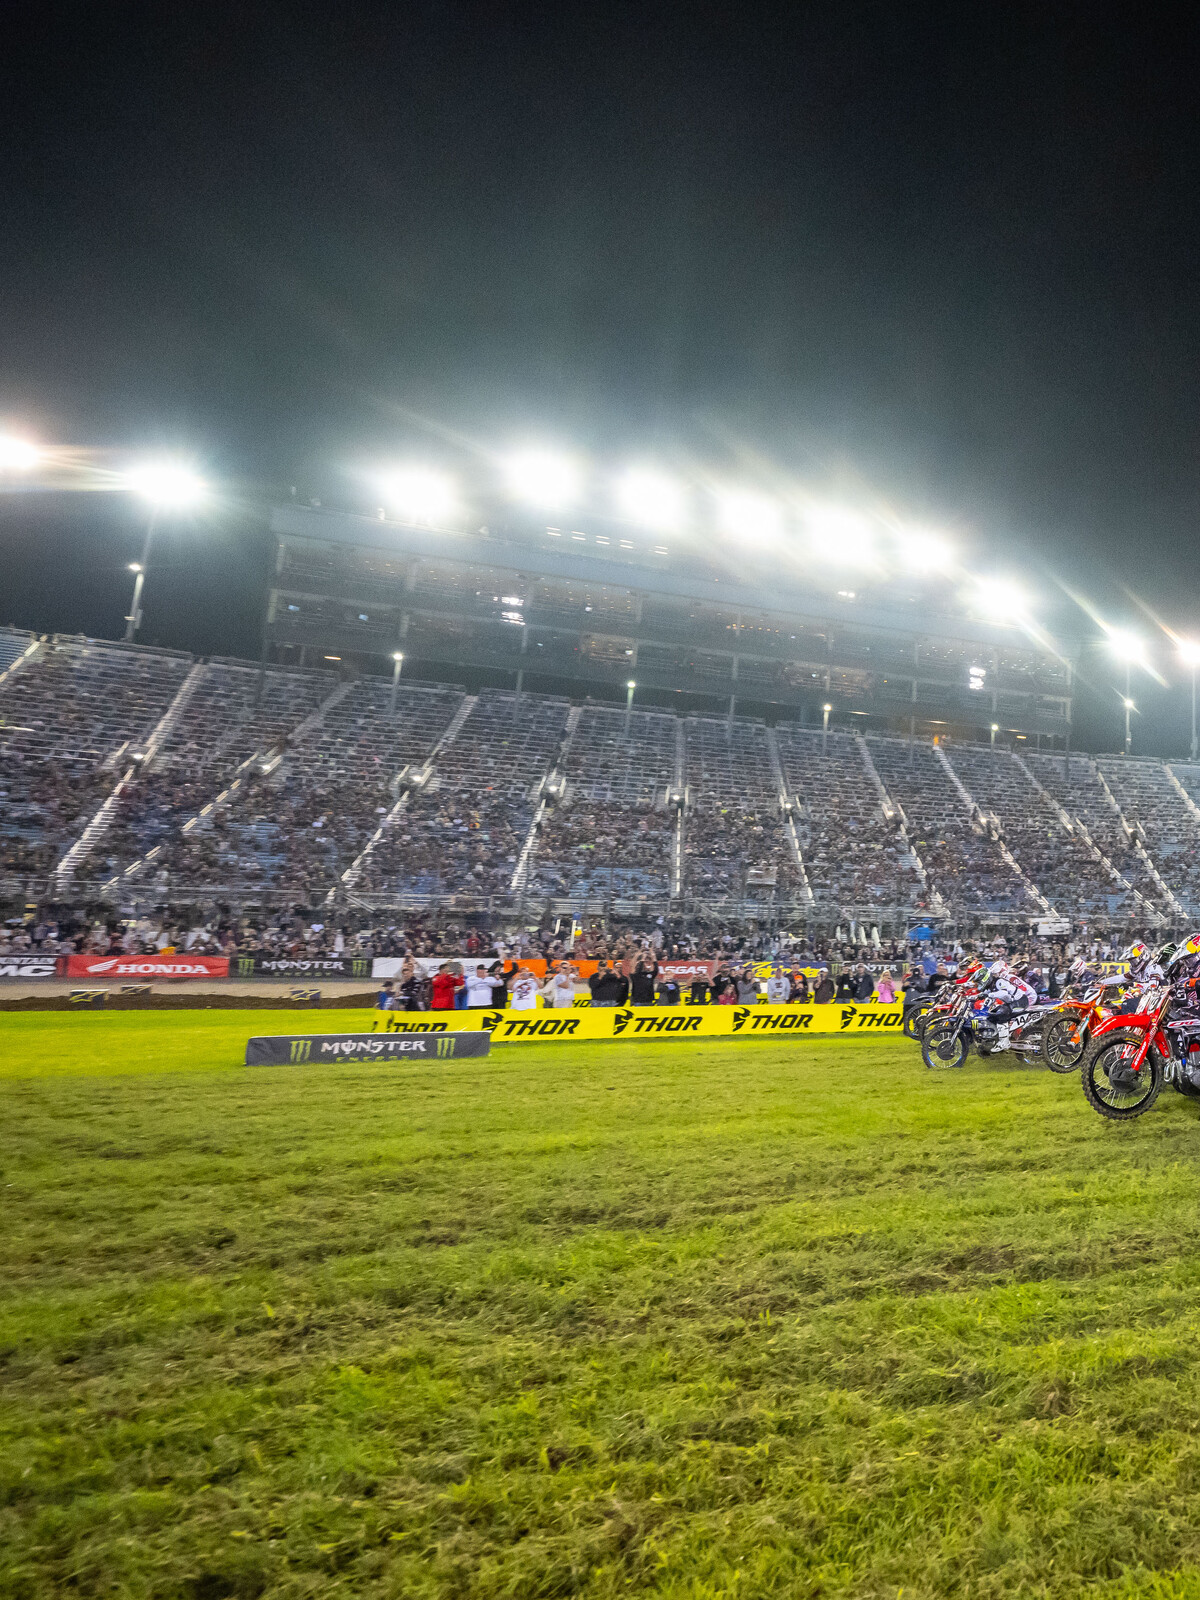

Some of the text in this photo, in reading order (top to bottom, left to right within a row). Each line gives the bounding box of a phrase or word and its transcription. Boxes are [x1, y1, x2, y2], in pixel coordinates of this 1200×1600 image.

[116, 964, 210, 974] HONDA
[261, 960, 345, 971] MONSTER
[634, 1016, 704, 1032] THOR
[751, 1014, 814, 1029] THOR
[856, 1013, 905, 1027] THO
[1015, 1015, 1025, 1026] 14
[504, 1019, 581, 1036] THOR
[321, 1040, 427, 1054] MONSTER
